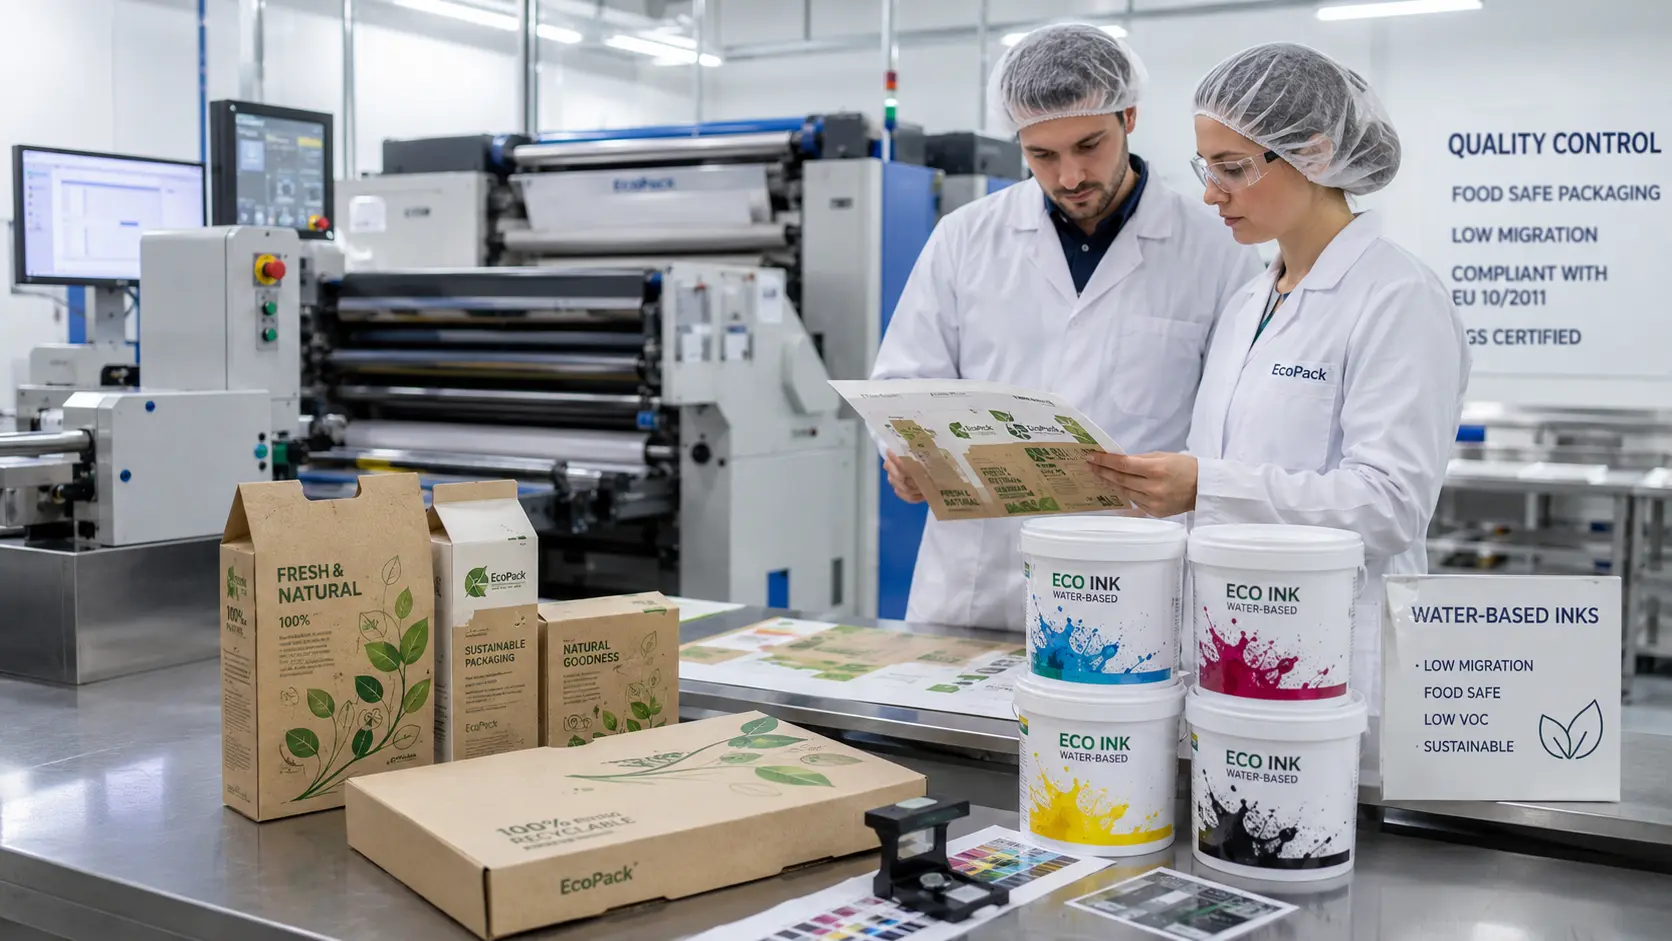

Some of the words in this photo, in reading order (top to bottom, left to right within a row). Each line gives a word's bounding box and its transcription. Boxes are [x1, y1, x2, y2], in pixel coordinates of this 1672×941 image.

[1448, 133, 1546, 158] QUALITY
[1553, 132, 1662, 154] CONTROL
[1452, 186, 1503, 202] FOOD
[1509, 186, 1552, 201] SAFE
[1559, 185, 1661, 201] PACKAGING
[1452, 227, 1493, 243] LOW
[1499, 227, 1598, 243] MIGRATION
[1452, 265, 1556, 282] COMPLIANT
[1562, 265, 1607, 281] WITH
[1452, 290, 1475, 306] EU
[1482, 289, 1546, 308] 10/2011
[1467, 329, 1488, 345] GS
[1493, 329, 1581, 345] CERTIFIED
[1271, 363, 1327, 381] EcoPack
[277, 563, 330, 583] FRESH
[332, 563, 344, 577] &
[491, 570, 526, 582] EcoPack
[1052, 572, 1085, 590] ECO
[1090, 575, 1121, 592] INK
[278, 581, 362, 604] NATURAL
[1052, 590, 1118, 604] WATER-BASED
[1226, 583, 1262, 601] ECO
[1268, 586, 1300, 603] INK
[1226, 601, 1298, 616] WATER-BASED
[1411, 606, 1549, 624] WATER-BASED
[1555, 607, 1600, 624] INKS
[279, 614, 310, 628] 100%
[465, 639, 526, 656] SUSTAINABLE
[563, 640, 611, 655] NATURAL
[465, 653, 515, 668] PACKAGING
[563, 652, 620, 668] GOODNESS
[1424, 660, 1455, 672] LOW
[1459, 660, 1534, 672] MIGRATION
[1424, 687, 1463, 699] FOOD
[1467, 687, 1501, 699] SAFE
[1424, 714, 1455, 726] LOW
[1460, 714, 1489, 726] VOC
[1059, 732, 1095, 750] ECO
[1100, 736, 1131, 752] INK
[1424, 740, 1515, 753] SUSTAINABLE
[1059, 750, 1128, 764] WATER-BASED
[1226, 749, 1262, 769] ECO
[1268, 755, 1301, 772] INK
[1226, 768, 1299, 785] WATER-BASED
[496, 818, 571, 836] 100%
[510, 816, 637, 844] RECYCLABLE
[560, 865, 633, 896] EcoPack
